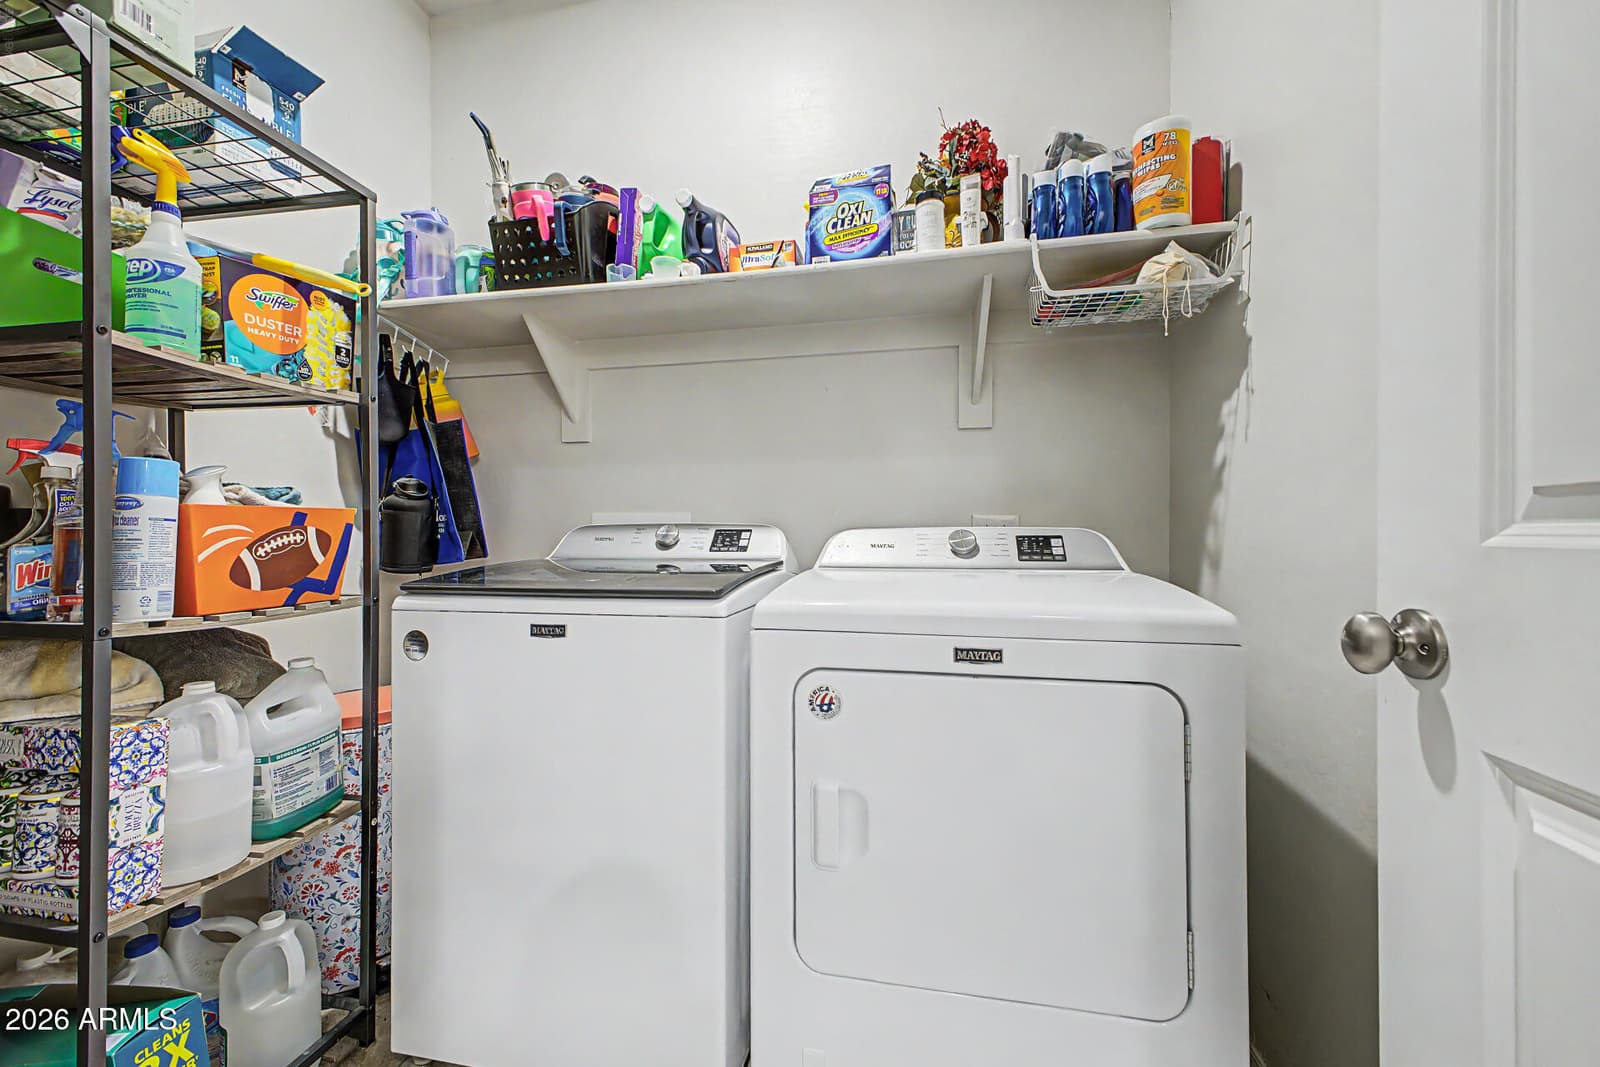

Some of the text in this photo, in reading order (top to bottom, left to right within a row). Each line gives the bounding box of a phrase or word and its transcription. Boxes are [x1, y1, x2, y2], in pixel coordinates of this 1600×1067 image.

[1164, 131, 1176, 141] 78
[24, 188, 81, 209] Lysol
[836, 200, 865, 219] OXI
[827, 209, 873, 235] CLEAN
[127, 259, 153, 277] ep
[245, 287, 297, 311] Swiffer
[244, 312, 302, 338] DUSTER
[247, 326, 300, 345] HEAVY DUTY
[230, 355, 239, 364] 11
[340, 348, 346, 356] 2
[531, 626, 565, 635] MAYTAG
[957, 650, 1001, 661] MAYTAG
[810, 685, 831, 713] AMERICA
[50, 900, 73, 909] BOTTLES
[133, 1017, 191, 1065] CLEANS
